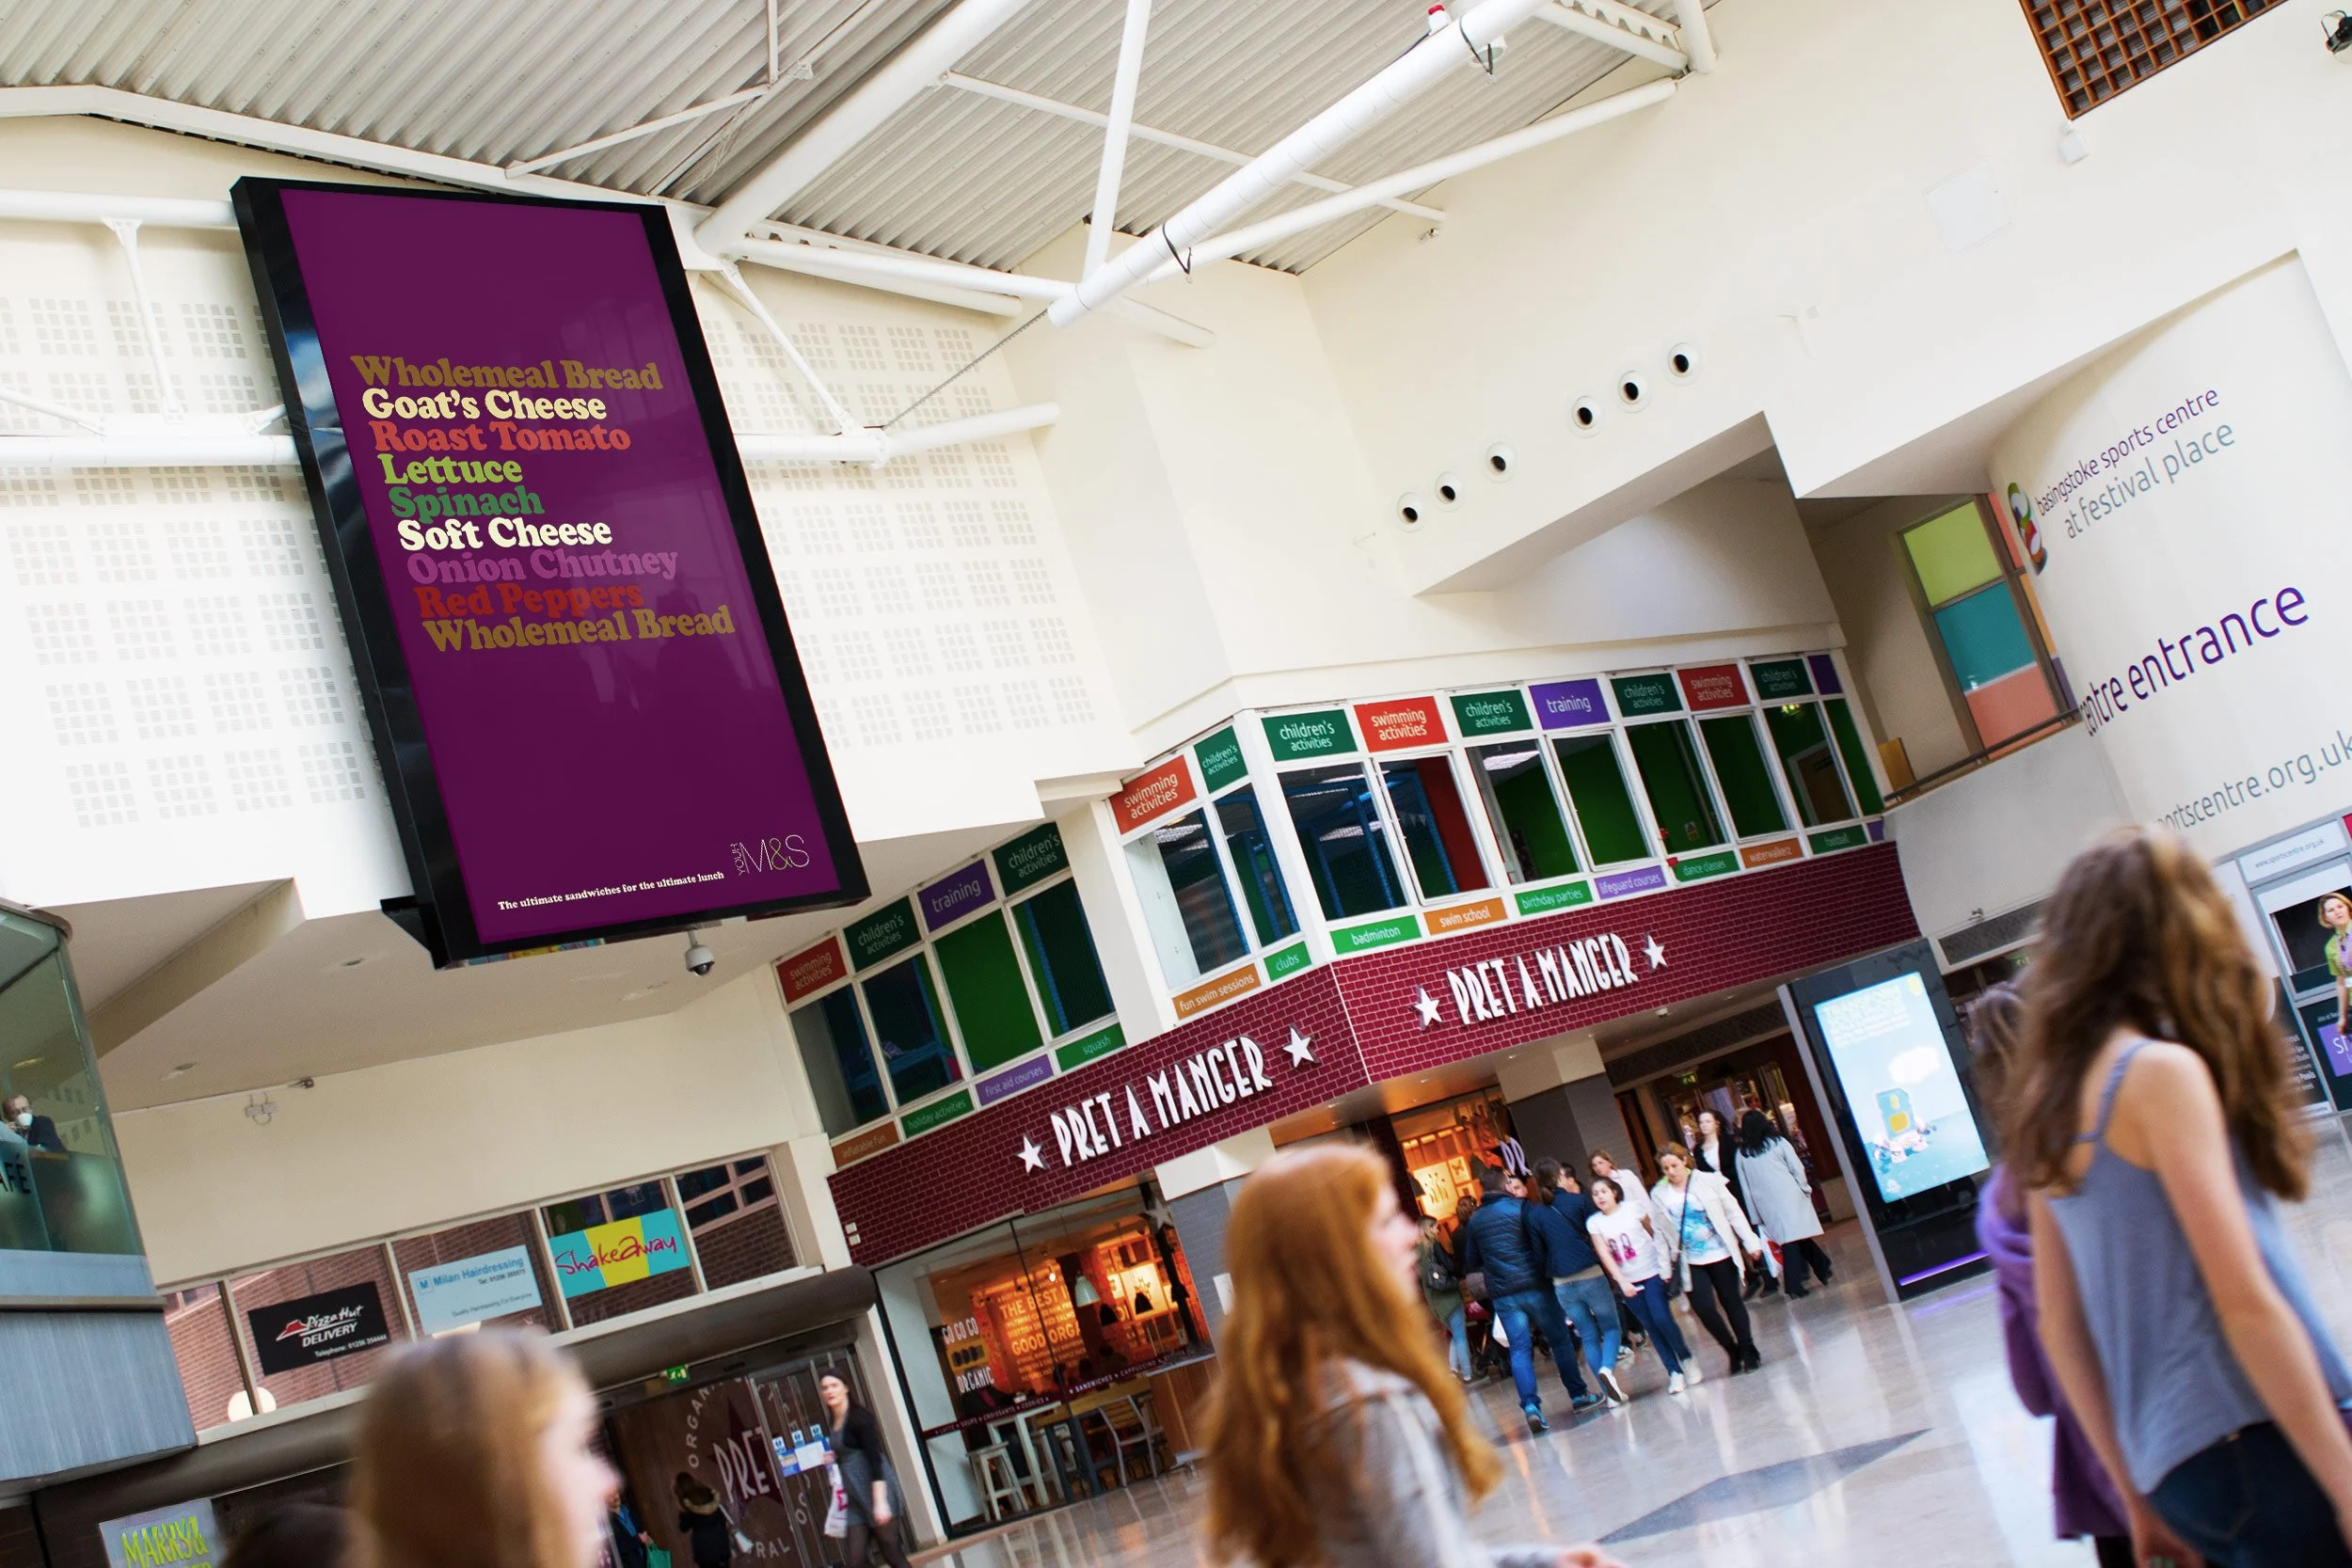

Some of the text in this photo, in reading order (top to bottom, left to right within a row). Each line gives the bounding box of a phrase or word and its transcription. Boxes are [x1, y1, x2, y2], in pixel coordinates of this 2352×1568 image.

[351, 356, 663, 390] Wholemeal Bread
[362, 388, 608, 420] Goat's Cheese
[368, 420, 631, 451] Roast Tomato
[2035, 389, 2219, 516] basingstoke sports centre
[377, 453, 522, 484] Lettuce
[2064, 423, 2236, 539] at festival place
[389, 485, 546, 523] Spinach
[397, 517, 613, 550] Soft Cheese
[406, 548, 678, 584] Onion Chutney
[413, 581, 644, 619] Red Peppers
[422, 605, 736, 652] Wholemeal Bread
[2128, 587, 2309, 701] entrance
[1624, 683, 1665, 700] children's
[1691, 674, 1732, 689] swimming
[1697, 688, 1734, 702] activities
[1466, 700, 1514, 718] children's
[1547, 695, 1591, 713] training
[1633, 696, 1664, 708] activities
[1279, 721, 1335, 740] children's
[1371, 709, 1427, 728] swimming
[1379, 722, 1427, 741] activities
[1475, 715, 1512, 728] activities
[1202, 743, 1238, 768] children's
[1291, 736, 1333, 752] activities
[1207, 755, 1238, 775] activities
[1124, 773, 1178, 809] swimming
[1131, 788, 1179, 820] activities
[739, 834, 809, 873] M&S
[1009, 833, 1061, 868] children's
[1018, 851, 1057, 878] activities
[1682, 860, 1727, 877] dance classes
[498, 871, 724, 911] The ultimate sandwiches for the ultimate lunch
[932, 879, 981, 912] training
[1599, 872, 1661, 895] lifeguard courses
[1521, 889, 1583, 910] birthday parties
[857, 913, 905, 946] children's
[1439, 906, 1490, 927] swim school
[866, 931, 901, 955] activities
[1351, 925, 1401, 945] badminton
[790, 952, 832, 979] swimming
[1276, 953, 1300, 972] clubs
[795, 965, 833, 990] activities
[1446, 932, 1640, 1025] PRET A MANGER
[1179, 974, 1255, 1013] fun swim sessions
[1083, 1036, 1111, 1055] squash
[985, 1066, 1044, 1098] first aid courses
[1050, 1035, 1273, 1167] PRET A MANGER
[554, 1235, 677, 1275] Shakeaway
[433, 1275, 460, 1288] Milan
[461, 1257, 524, 1279] Hairdressing
[307, 1305, 364, 1329] Pizza Hut
[999, 1300, 1025, 1320] THE
[1026, 1288, 1057, 1310] BEST
[302, 1322, 358, 1348] DELIVERY
[1011, 1333, 1046, 1355] GOOD
[957, 1367, 994, 1393] ORGANIC
[1075, 1360, 1157, 1393] SANDWICHES CAPPUCCINO
[712, 1426, 781, 1504] PRET
